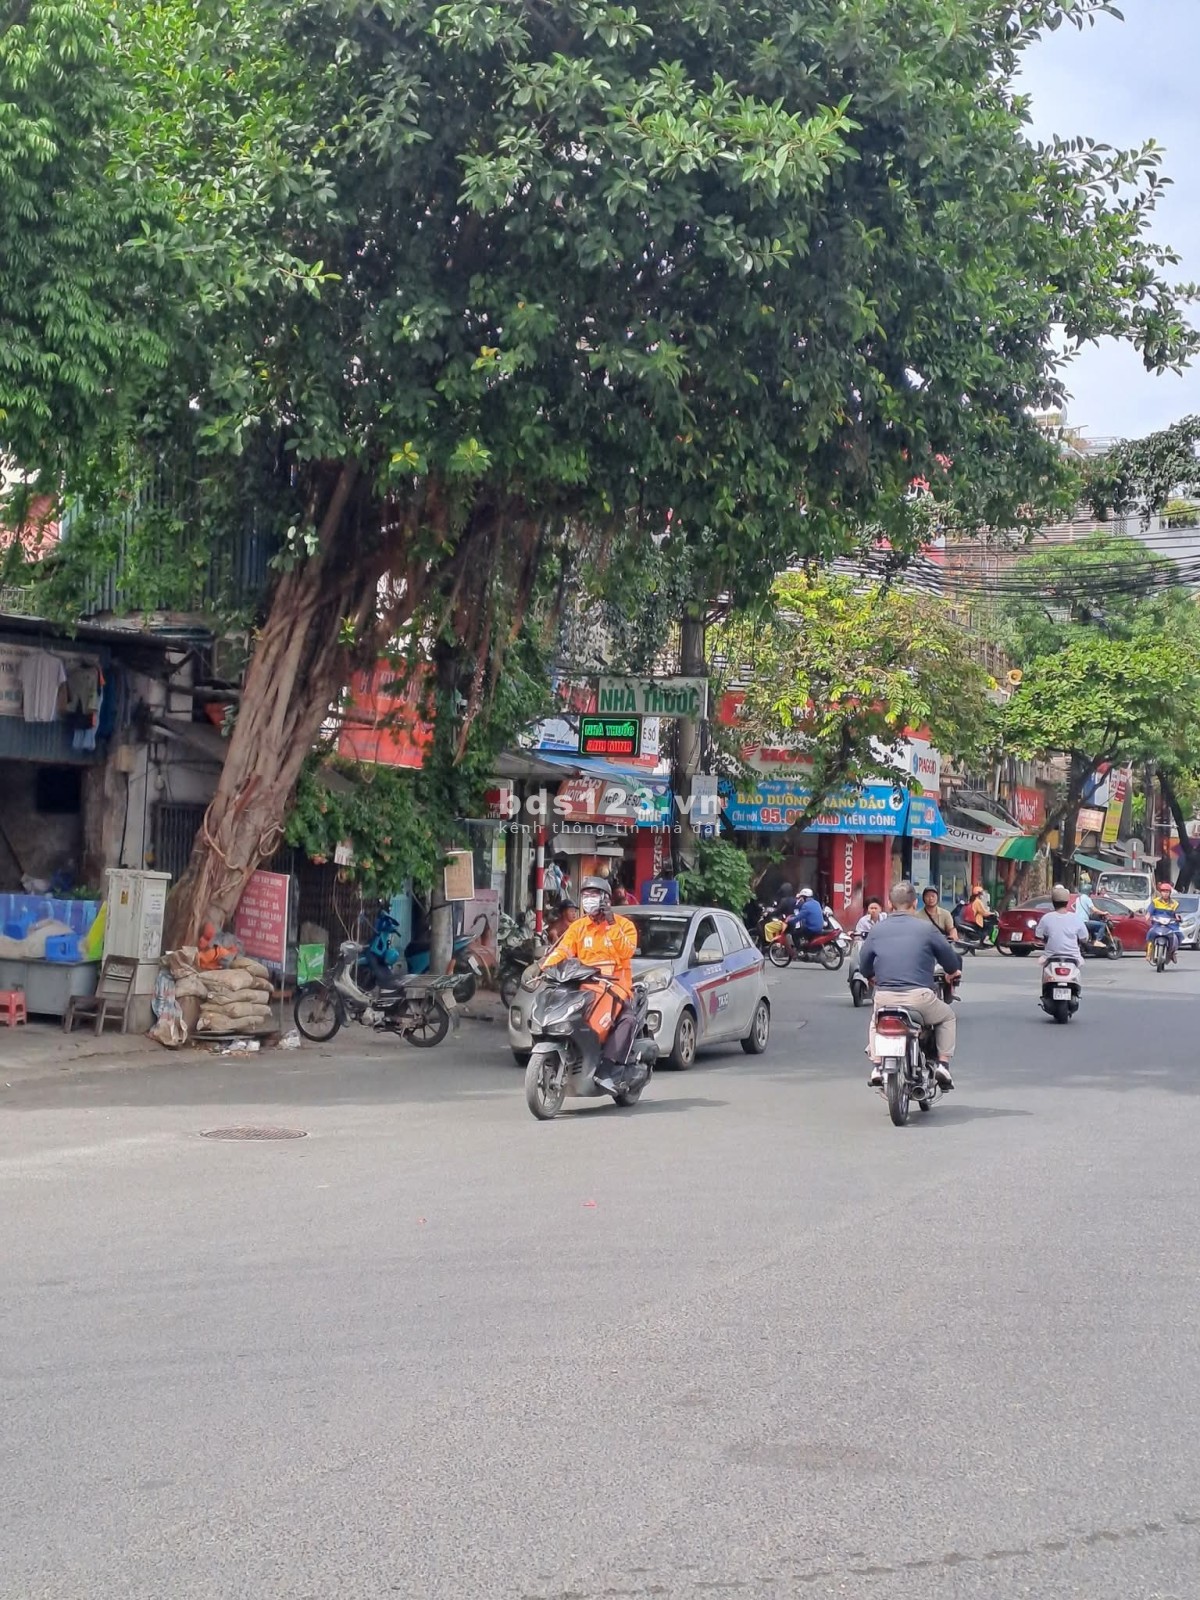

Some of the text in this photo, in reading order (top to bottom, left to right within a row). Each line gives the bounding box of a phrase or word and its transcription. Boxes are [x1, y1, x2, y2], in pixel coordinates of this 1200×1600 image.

[585, 722, 635, 736] NHÀ THUỐC
[918, 756, 937, 775] PIAGGIO
[947, 827, 985, 843] ROHTO
[844, 842, 854, 910] HONDA
[650, 884, 668, 902] G7
